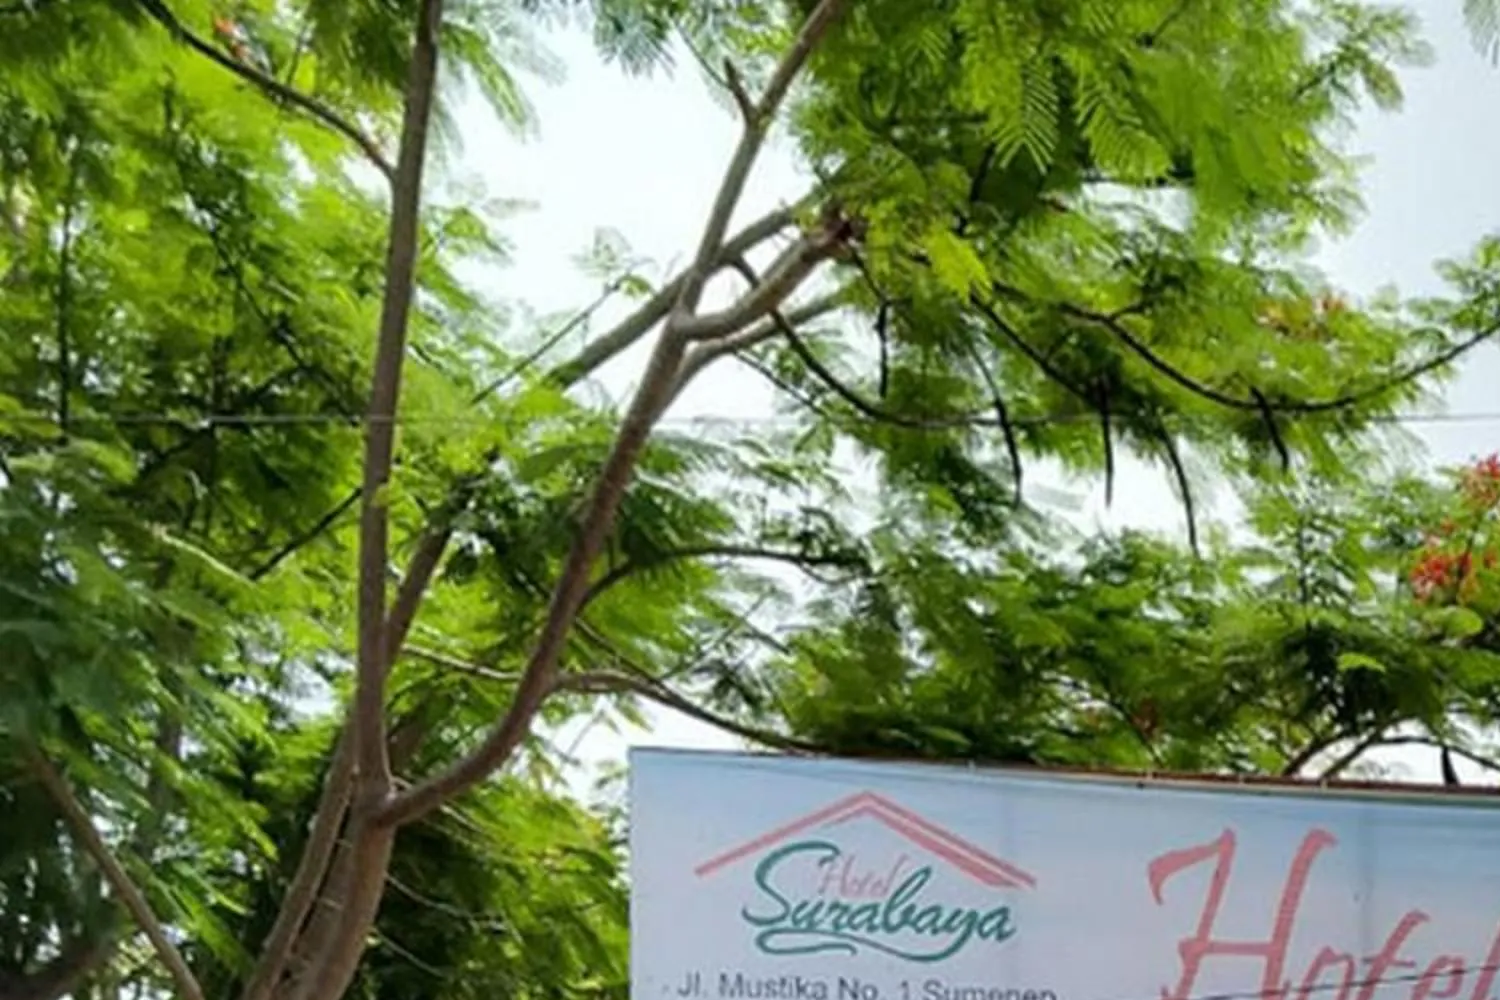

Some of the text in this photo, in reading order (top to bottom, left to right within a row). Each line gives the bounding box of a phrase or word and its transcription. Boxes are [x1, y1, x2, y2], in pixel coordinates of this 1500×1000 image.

[742, 841, 1016, 962] Surabaya
[718, 972, 828, 1000] Mustika
[901, 980, 910, 1000] 1
